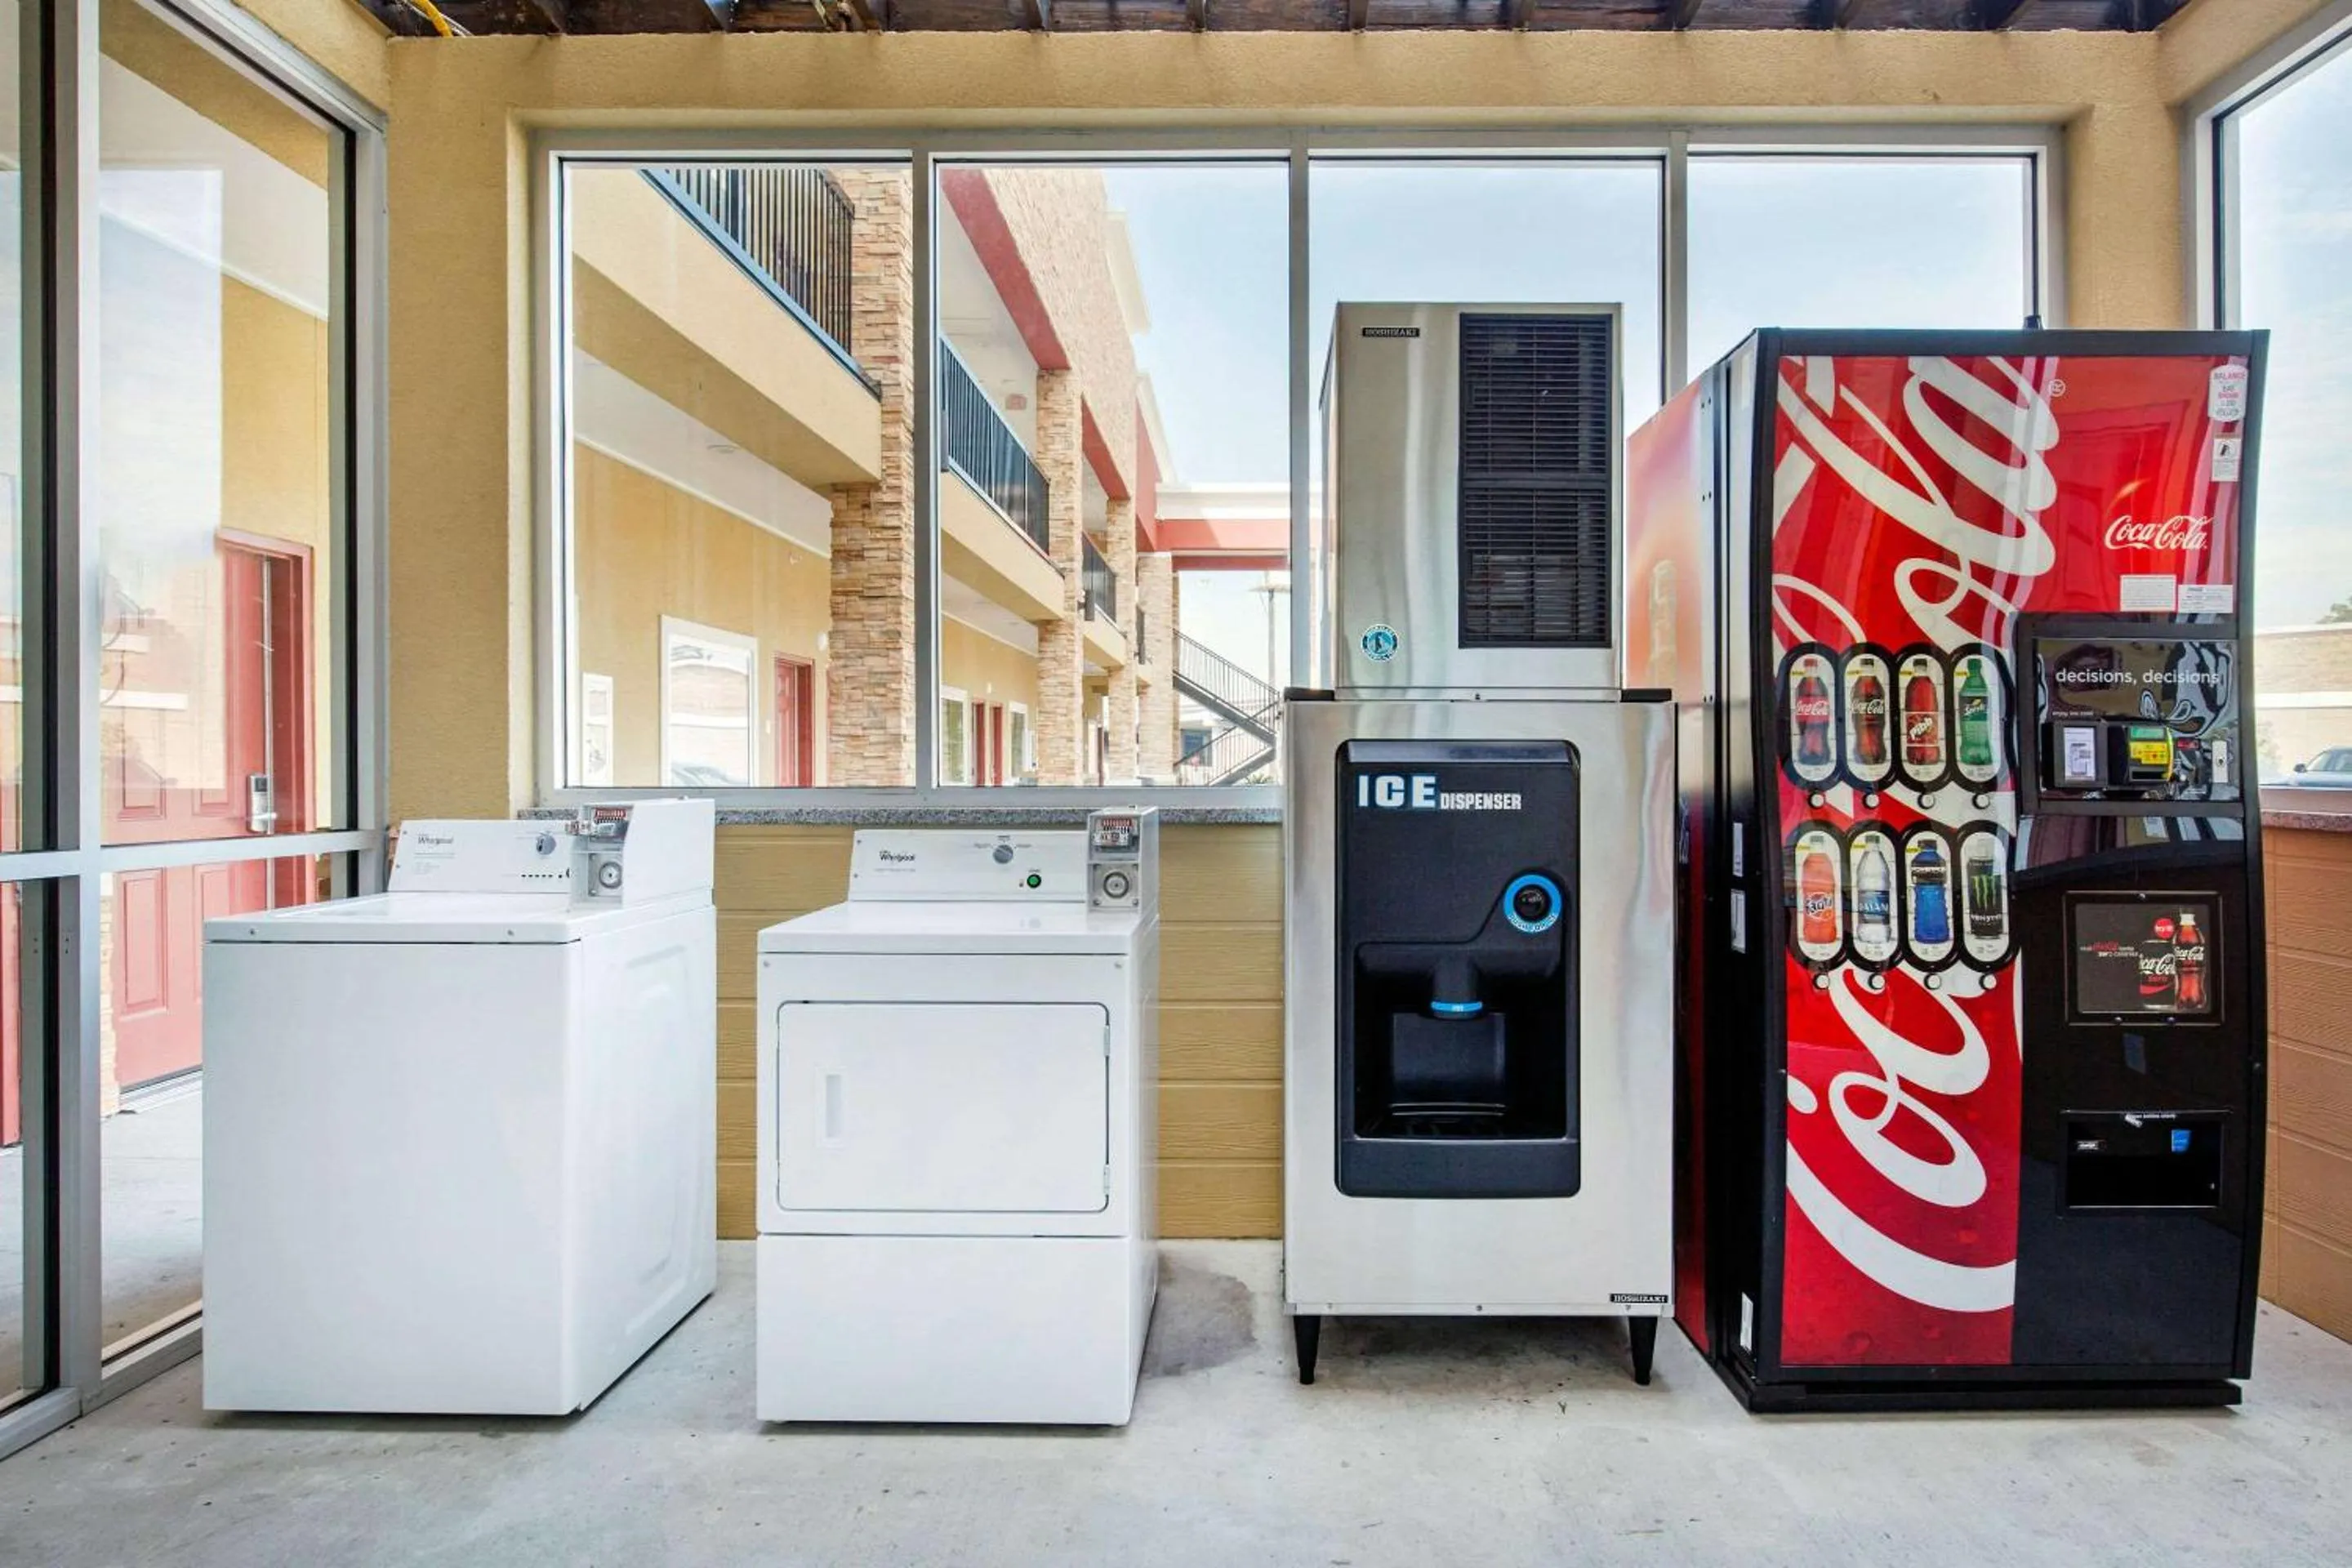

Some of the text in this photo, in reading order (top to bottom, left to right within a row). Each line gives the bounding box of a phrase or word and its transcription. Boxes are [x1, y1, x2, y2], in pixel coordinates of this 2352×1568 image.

[2105, 515, 2214, 550] Coca-Cola
[2055, 668, 2220, 686] decisions, decisions
[1358, 775, 1521, 809] ICE DISPENSER
